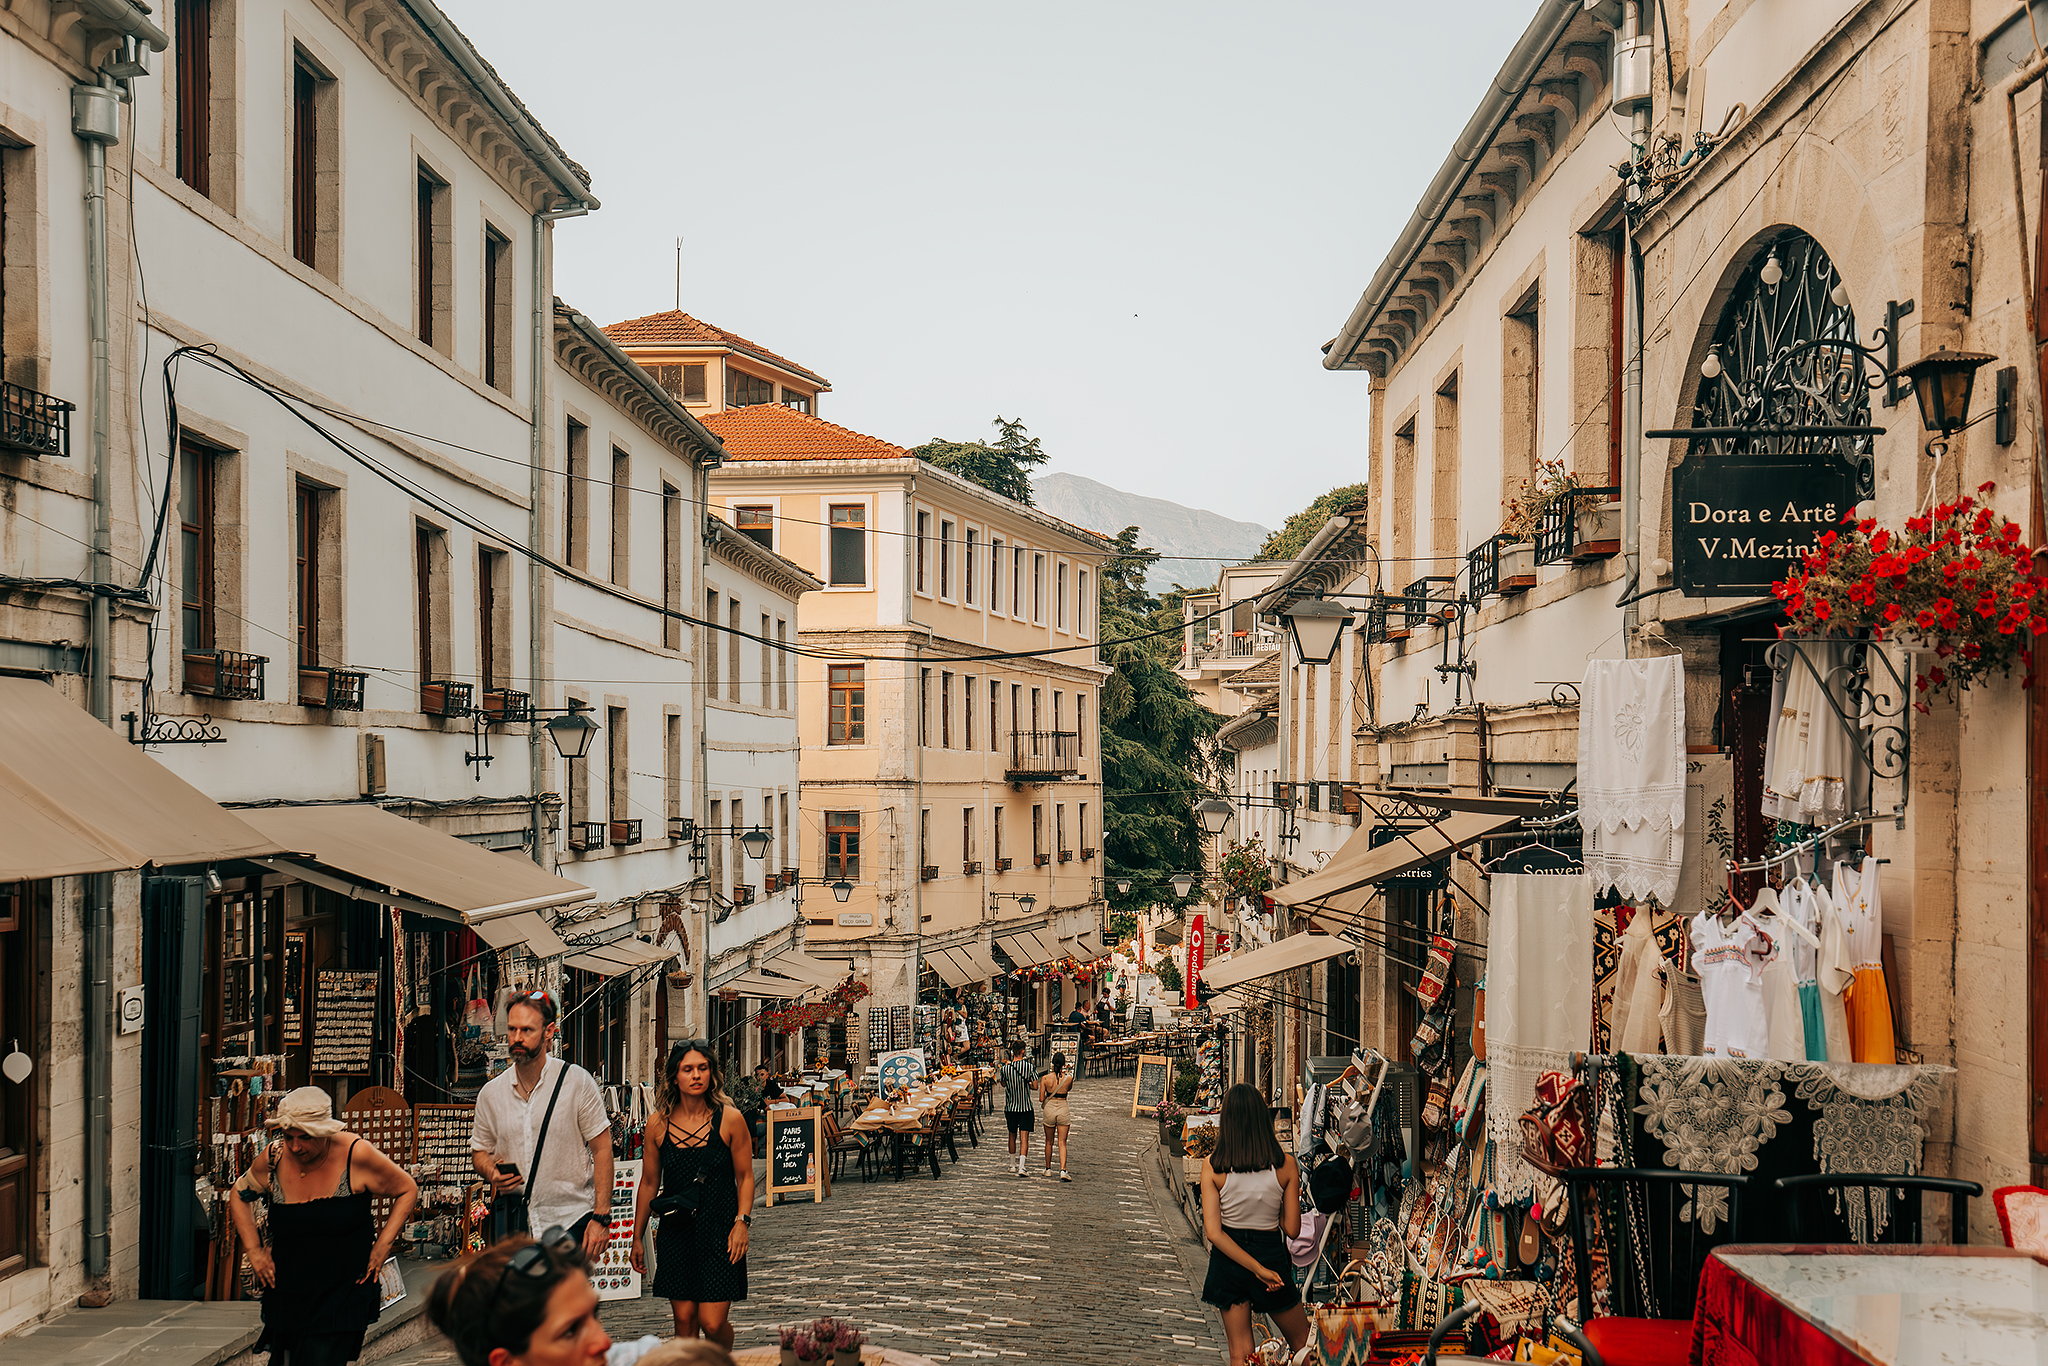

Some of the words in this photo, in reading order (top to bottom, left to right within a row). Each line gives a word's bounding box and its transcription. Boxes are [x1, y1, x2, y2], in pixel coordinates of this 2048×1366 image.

[1688, 502, 1751, 523] Dora
[1758, 508, 1772, 523] e
[1779, 501, 1837, 523] Artë
[1191, 949, 1199, 996] vodafone
[783, 1127, 802, 1135] PARIS
[783, 1142, 806, 1150] ALWAYS
